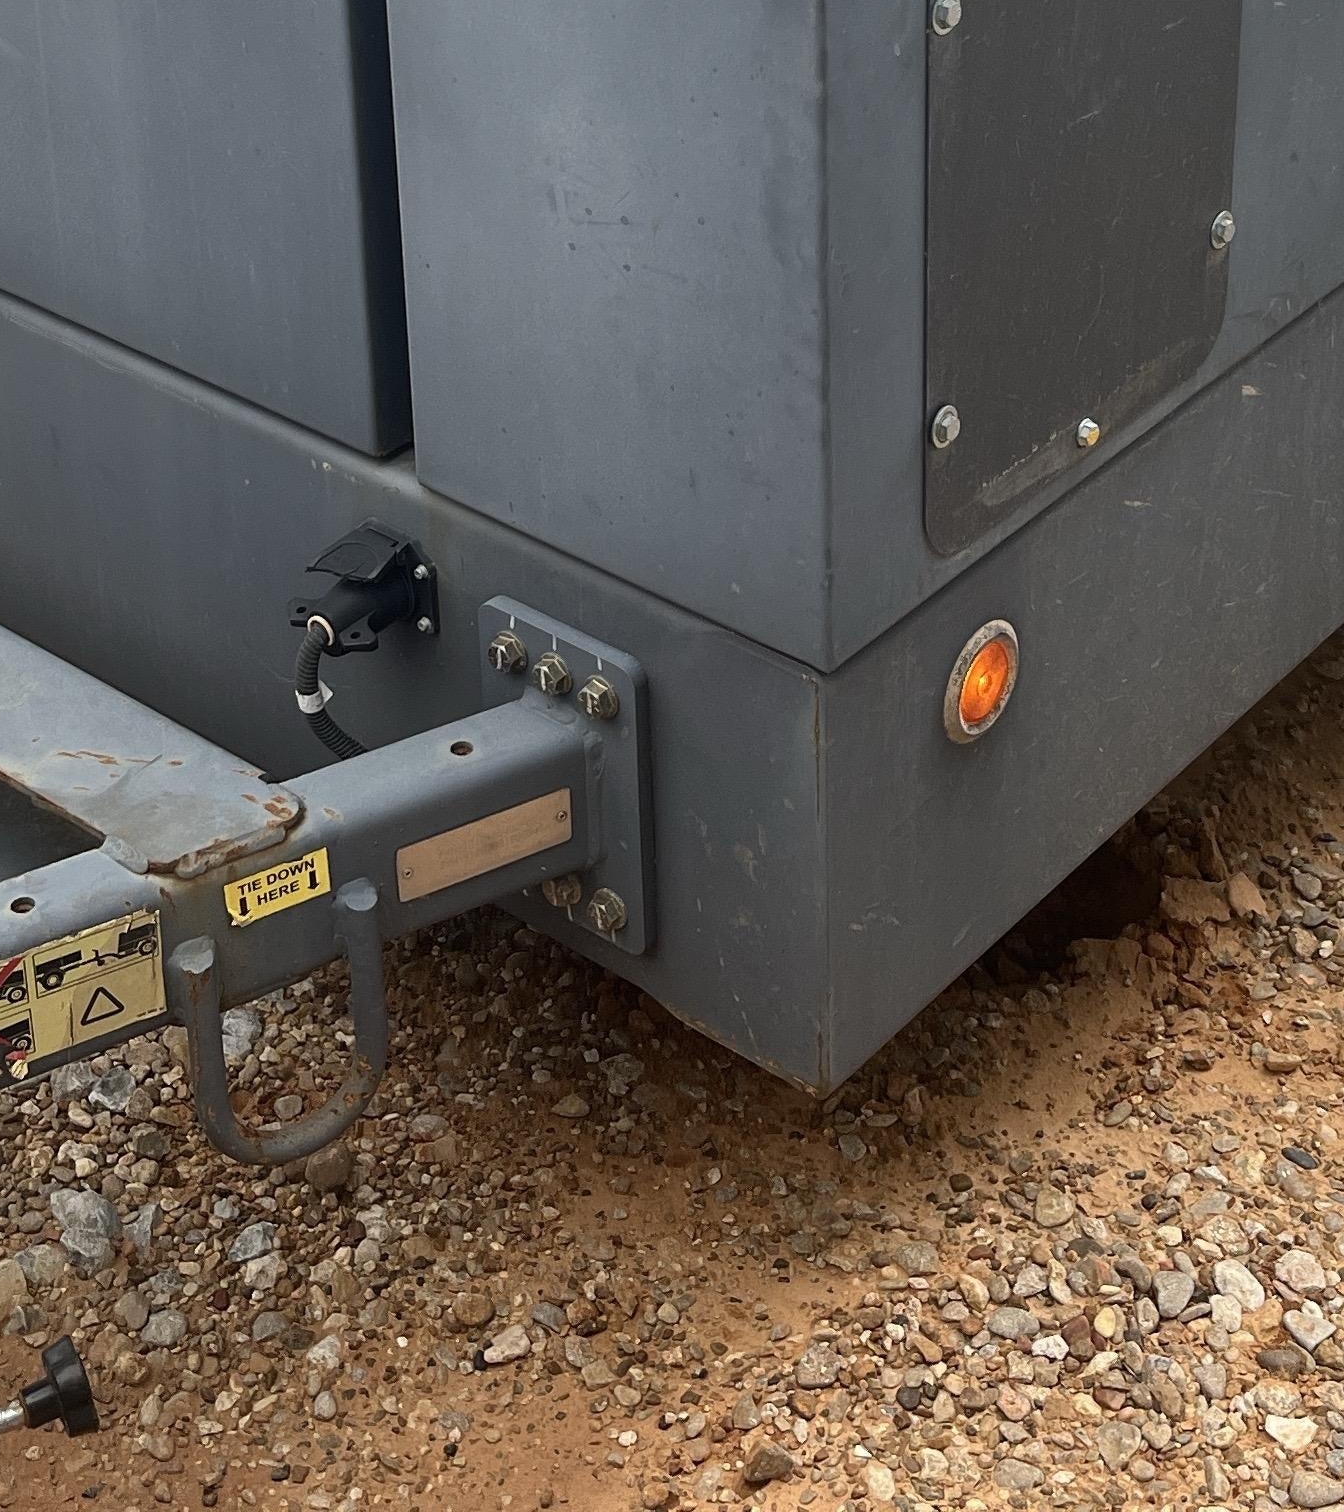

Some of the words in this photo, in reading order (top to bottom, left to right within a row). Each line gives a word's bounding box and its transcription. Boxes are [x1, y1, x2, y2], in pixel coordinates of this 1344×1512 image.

[238, 879, 263, 896] TIE
[267, 858, 316, 886] DOWN
[256, 880, 301, 906] HERE
